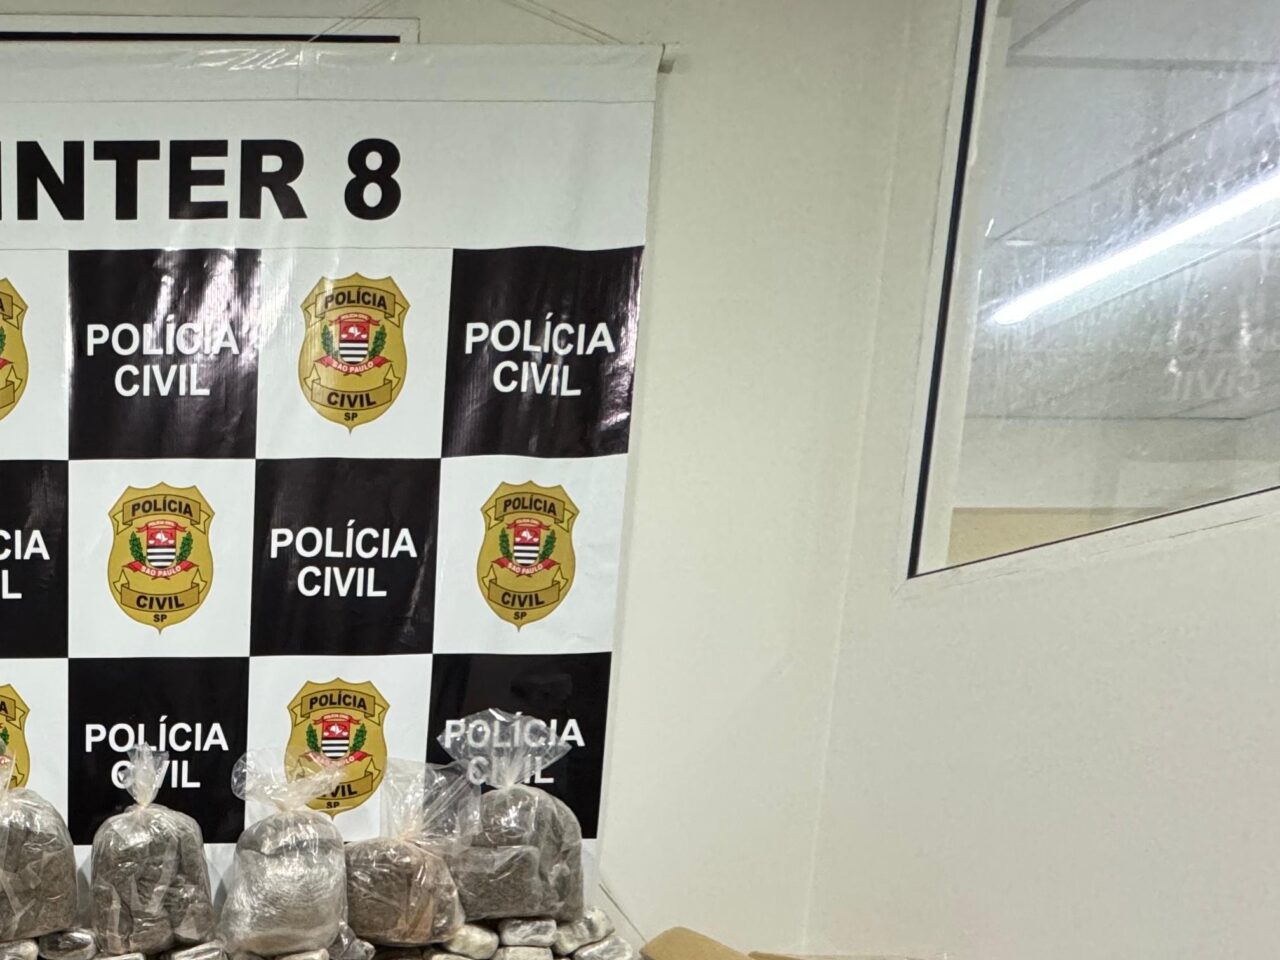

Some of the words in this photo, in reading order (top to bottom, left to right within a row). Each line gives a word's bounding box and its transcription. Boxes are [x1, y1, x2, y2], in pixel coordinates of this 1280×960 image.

[345, 138, 401, 220] 8
[324, 288, 387, 310] POLÍCIA
[87, 314, 240, 356] POLÍCIA
[466, 312, 616, 355] POLÍCIA
[349, 361, 374, 373] PAULO
[114, 363, 210, 396] CIVIL
[493, 360, 581, 396] CIVIL
[327, 392, 376, 408] CIVIL
[344, 412, 358, 421] SP
[131, 495, 193, 517] POLÍCIA
[503, 495, 557, 516] POLÍCIA
[271, 520, 417, 558] POLÍCIA
[158, 566, 181, 578] PAULO
[522, 563, 544, 575] PAULO
[298, 566, 386, 596] CIVIL
[136, 595, 185, 610] CIVIL
[501, 592, 545, 607] CIVIL
[153, 614, 167, 622] SP
[513, 611, 527, 620] SP
[309, 691, 367, 711] POLÍCIA
[85, 715, 229, 752] POLÍCIA
[444, 712, 585, 747] POLÍCIA
[111, 760, 201, 789] CVIL
[321, 784, 358, 798] VIL
[326, 801, 340, 809] SP
